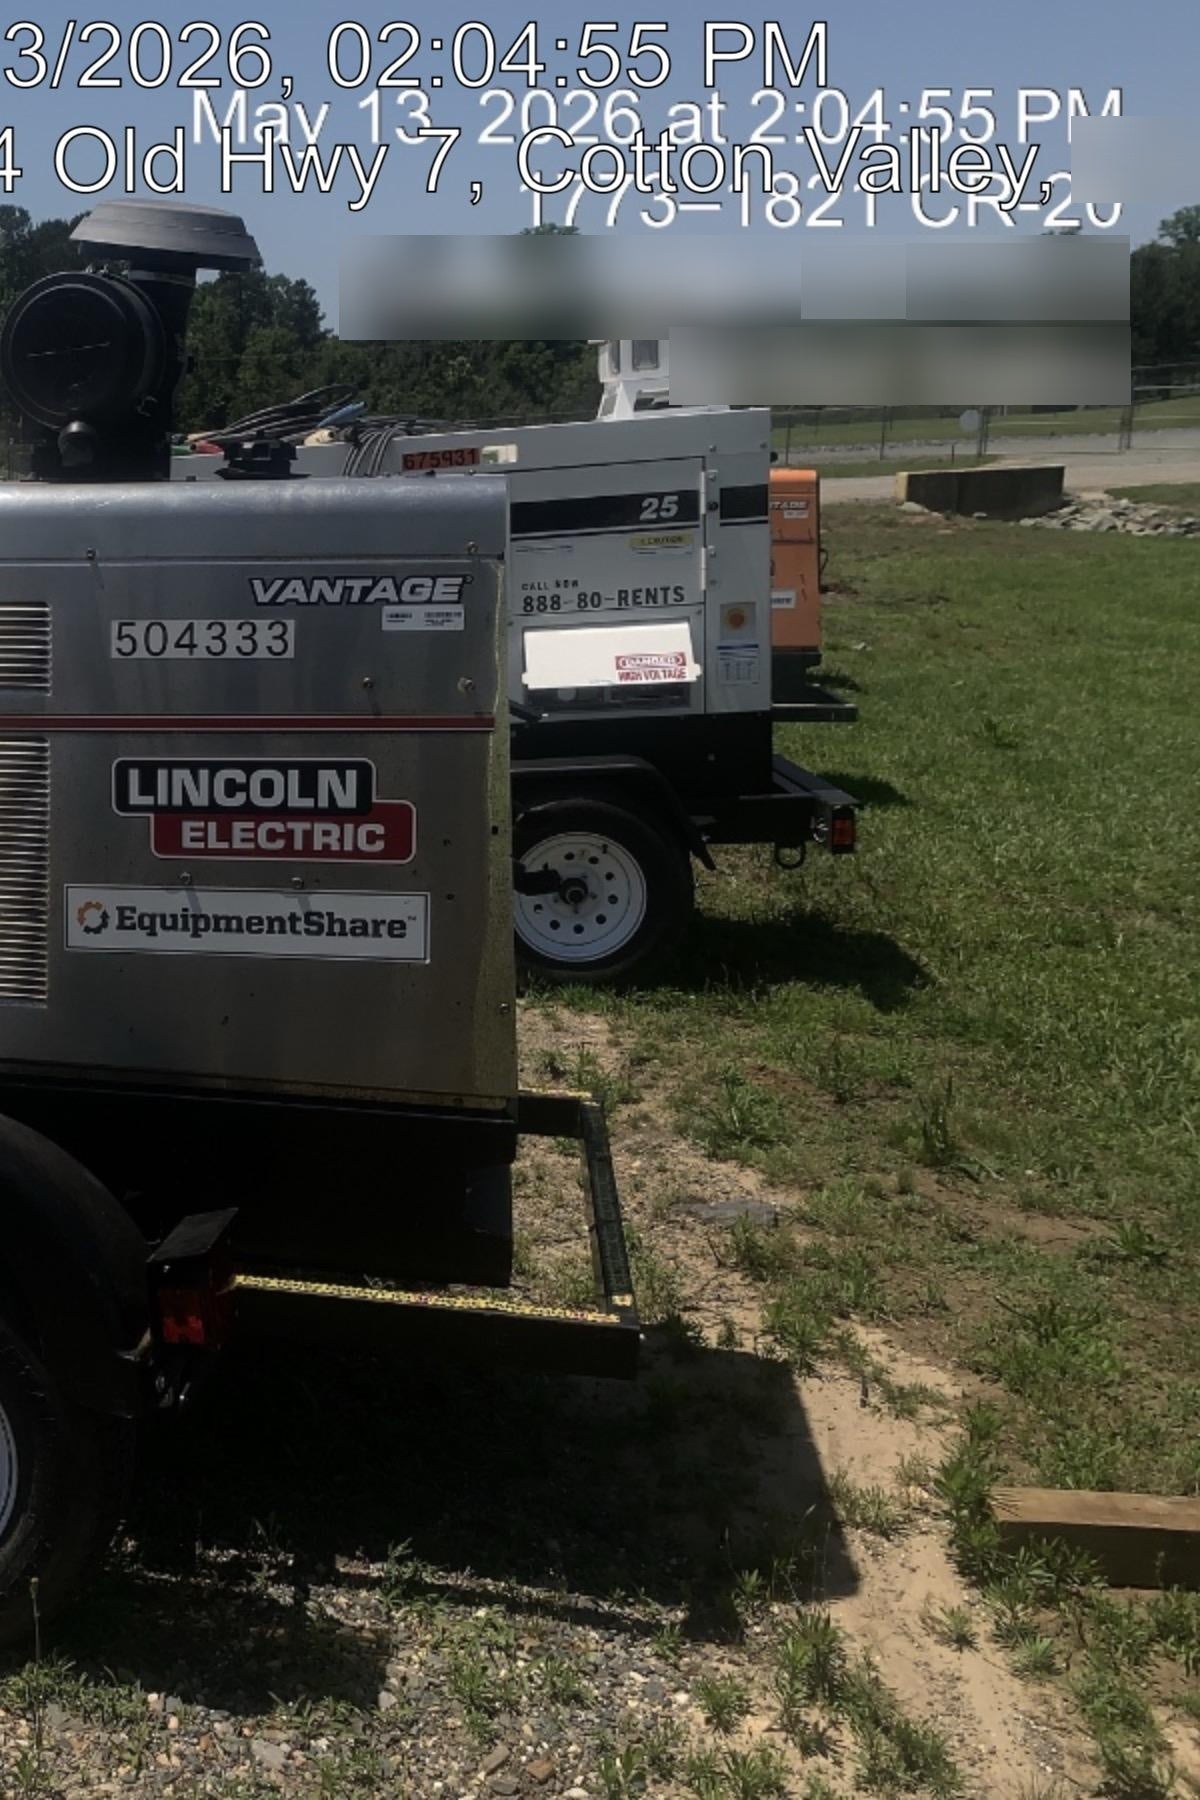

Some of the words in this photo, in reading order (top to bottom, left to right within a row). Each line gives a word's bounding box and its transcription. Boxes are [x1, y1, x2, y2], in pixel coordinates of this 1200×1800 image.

[403, 449, 477, 470] 675931
[639, 495, 679, 521] 25
[251, 577, 463, 604] VANTAGE
[521, 582, 549, 591] CALL
[115, 621, 290, 657] 504333
[128, 768, 357, 808] LINCOLN
[181, 821, 386, 852] ELECTRIC
